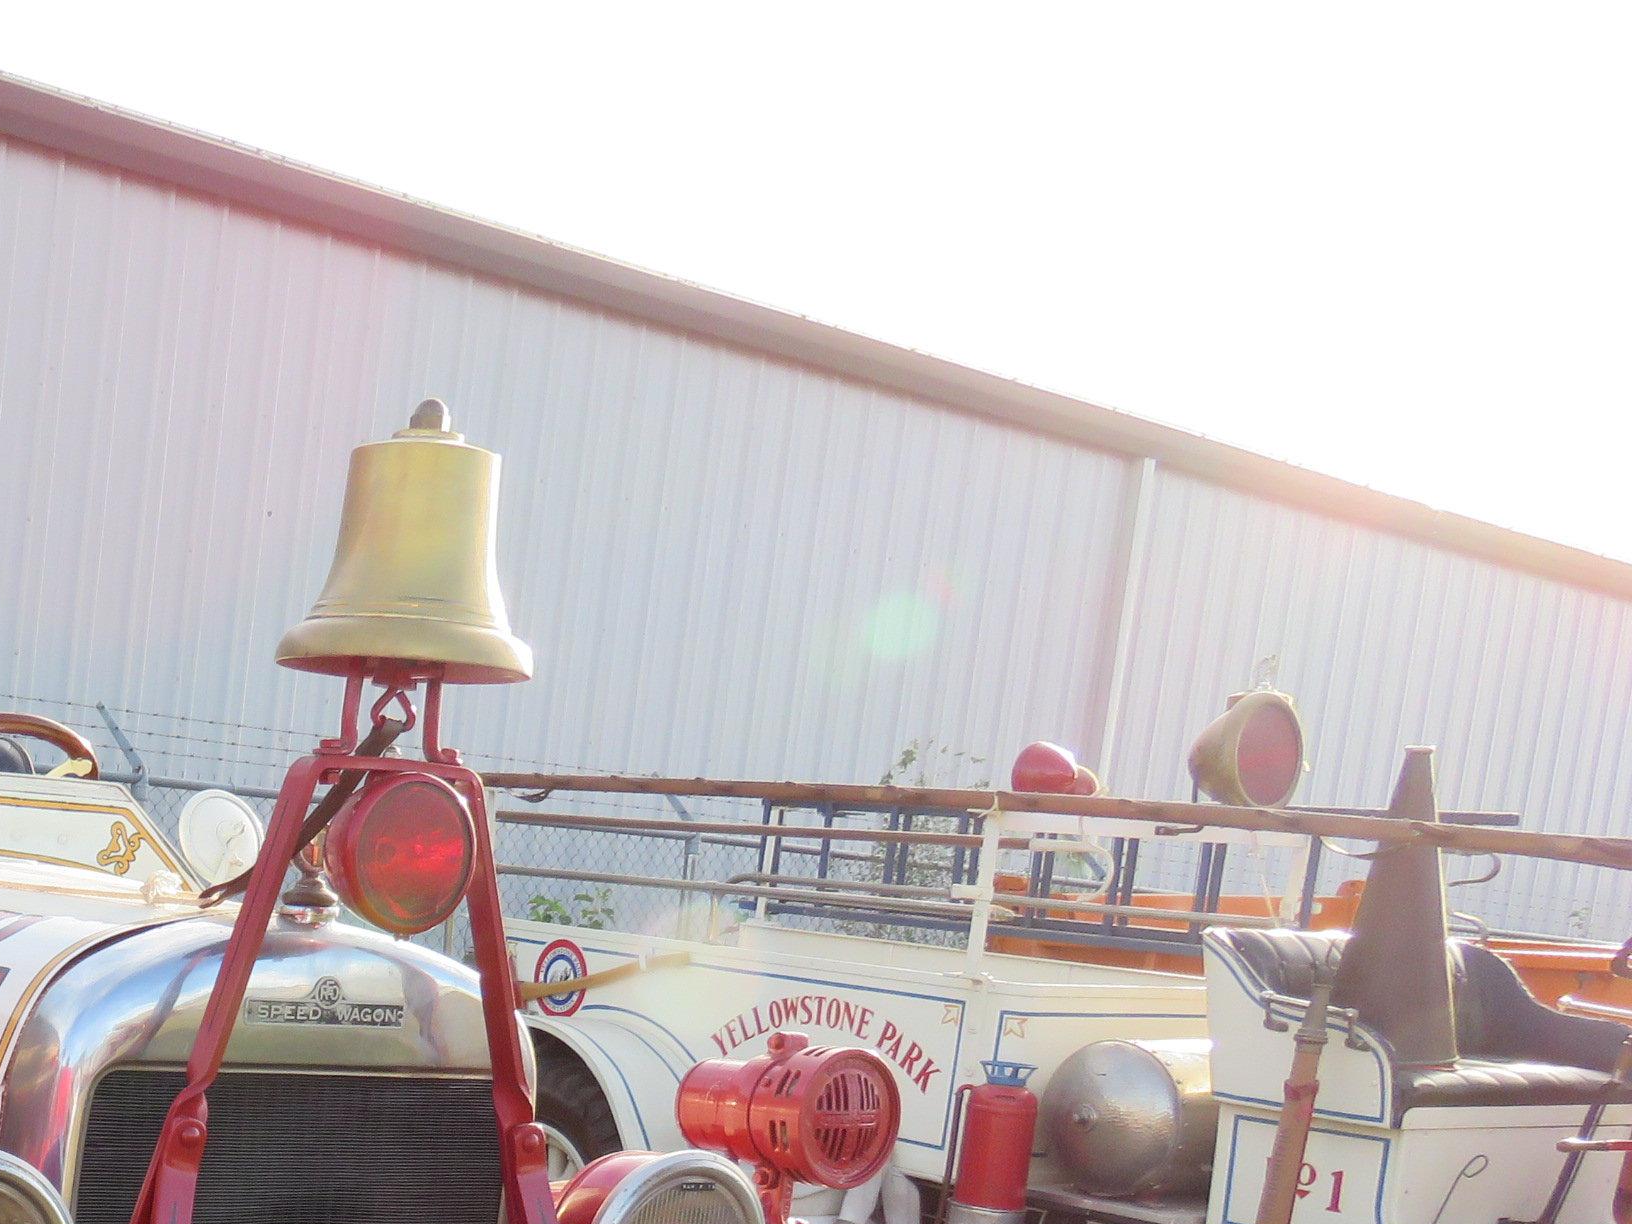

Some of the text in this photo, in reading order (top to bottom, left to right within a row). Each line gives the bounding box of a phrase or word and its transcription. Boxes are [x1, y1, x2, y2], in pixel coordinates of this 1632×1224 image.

[256, 1004, 399, 1023] SPEED WAGON
[710, 996, 942, 1095] YELLOWSTONE PARK
[1325, 1170, 1344, 1213] 1
